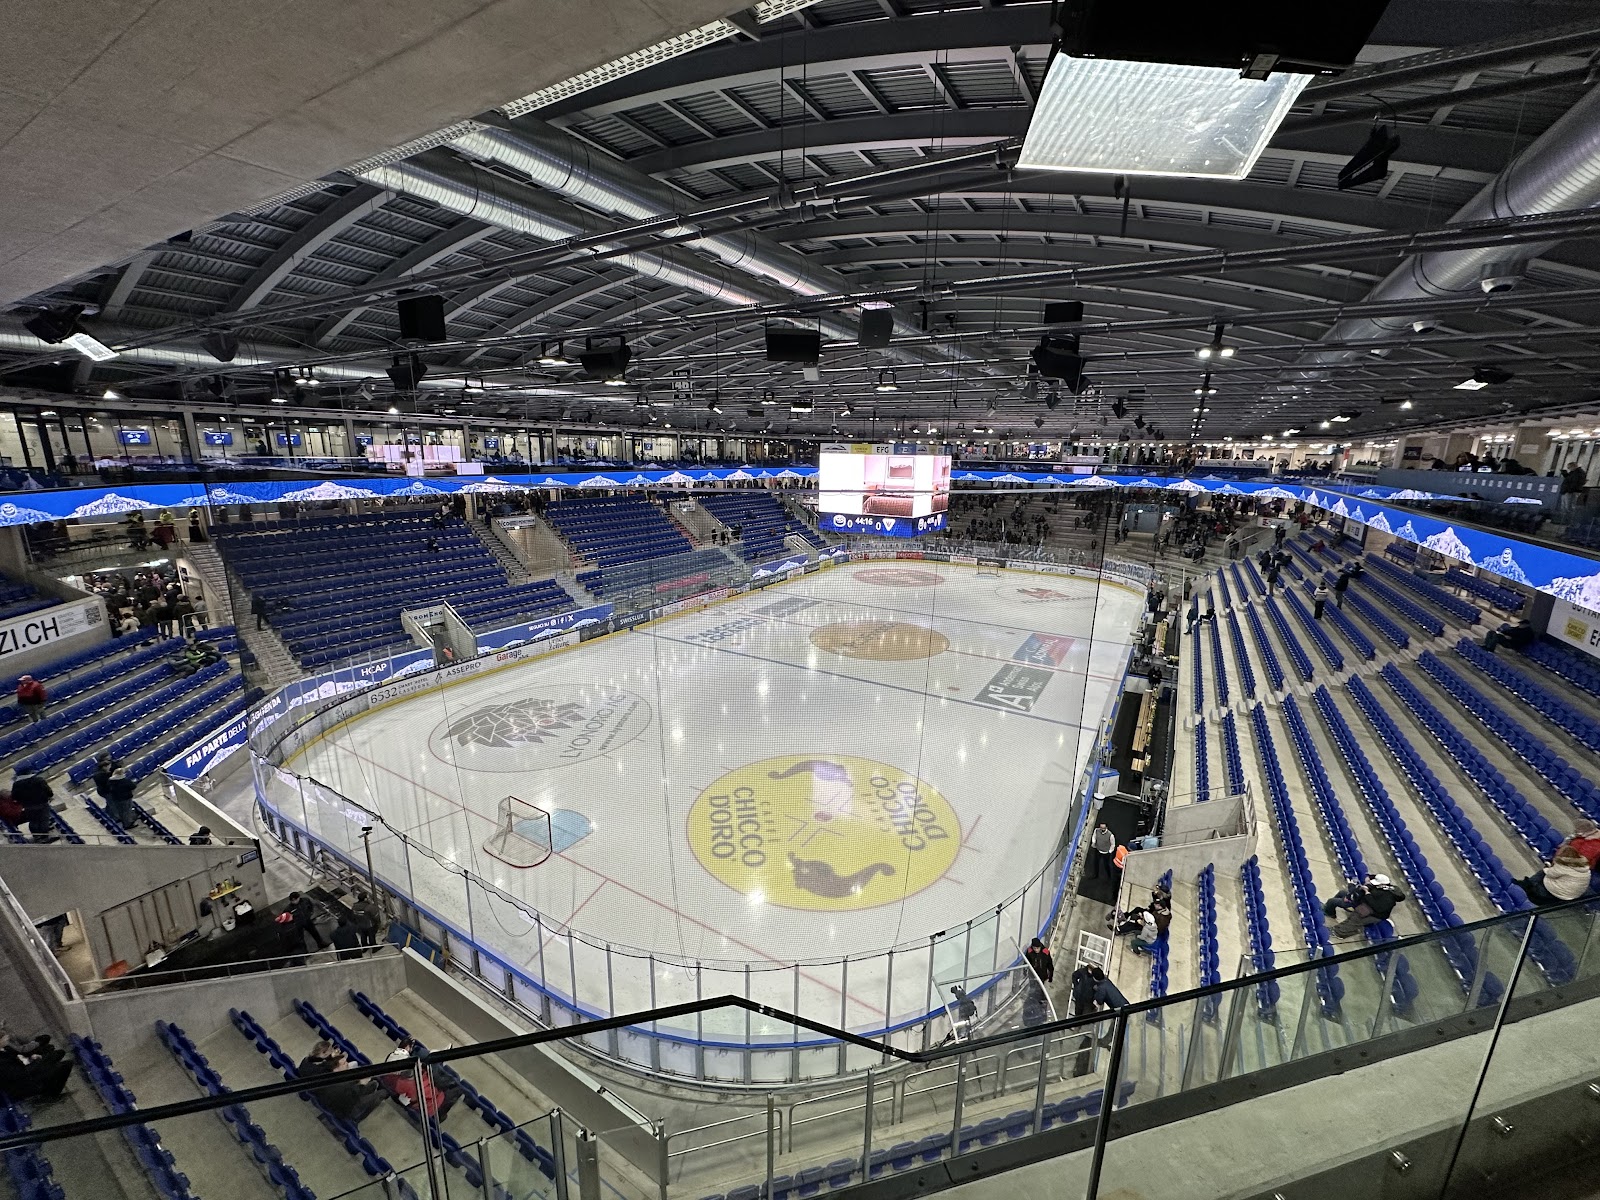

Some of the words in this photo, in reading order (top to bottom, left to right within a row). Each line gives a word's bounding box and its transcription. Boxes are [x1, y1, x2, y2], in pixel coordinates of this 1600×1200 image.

[876, 446, 889, 454] EFG
[847, 519, 853, 528] 0
[855, 517, 873, 526] 44:16
[875, 521, 881, 531] 0
[620, 613, 645, 625] SWISSLUX
[496, 650, 522, 662] Garage
[361, 663, 388, 677] HCAP
[446, 661, 481, 677] ASSEPRO
[371, 687, 398, 704] 6532
[186, 750, 202, 768] FAI
[202, 731, 228, 757] PARTE
[227, 721, 247, 739] DELLA
[870, 775, 926, 852] CHICCO
[733, 786, 766, 868] CHICCO
